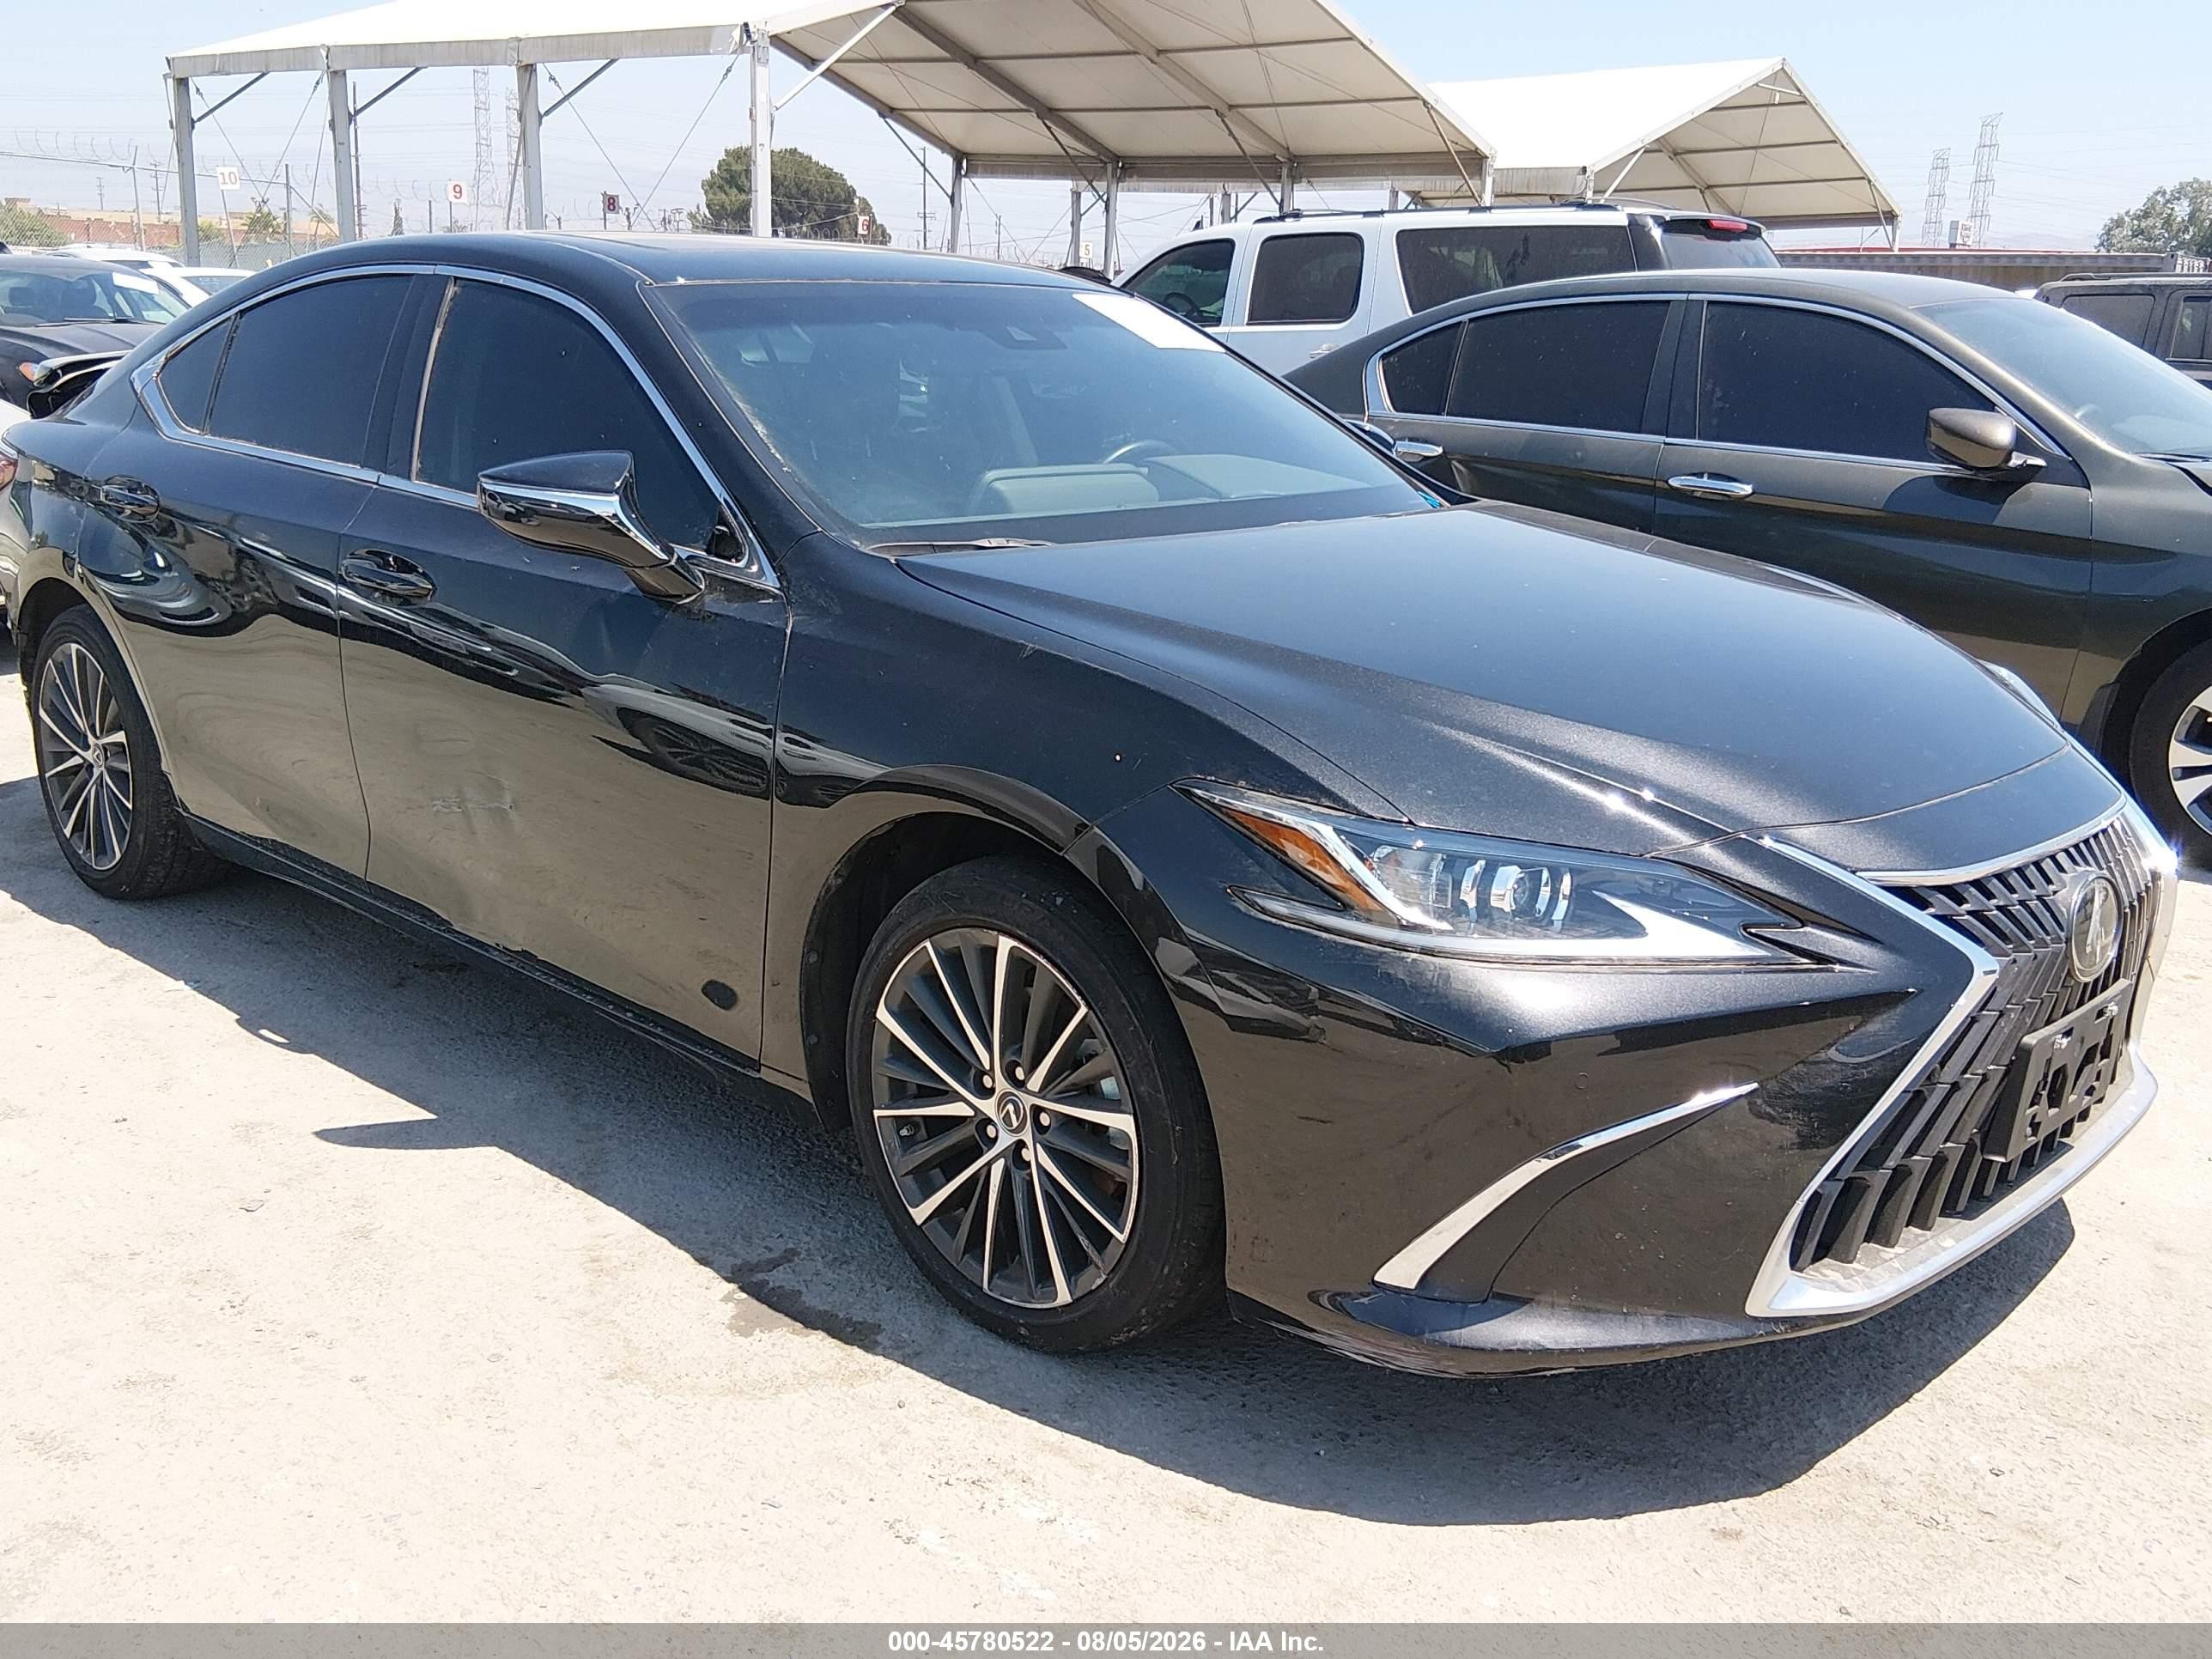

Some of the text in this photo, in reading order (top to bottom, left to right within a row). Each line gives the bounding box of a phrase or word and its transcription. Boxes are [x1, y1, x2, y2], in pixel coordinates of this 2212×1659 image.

[219, 171, 238, 185] 10
[453, 184, 463, 200] 9
[607, 197, 617, 212] 8
[861, 218, 870, 232] 6
[1084, 244, 1091, 256] 5
